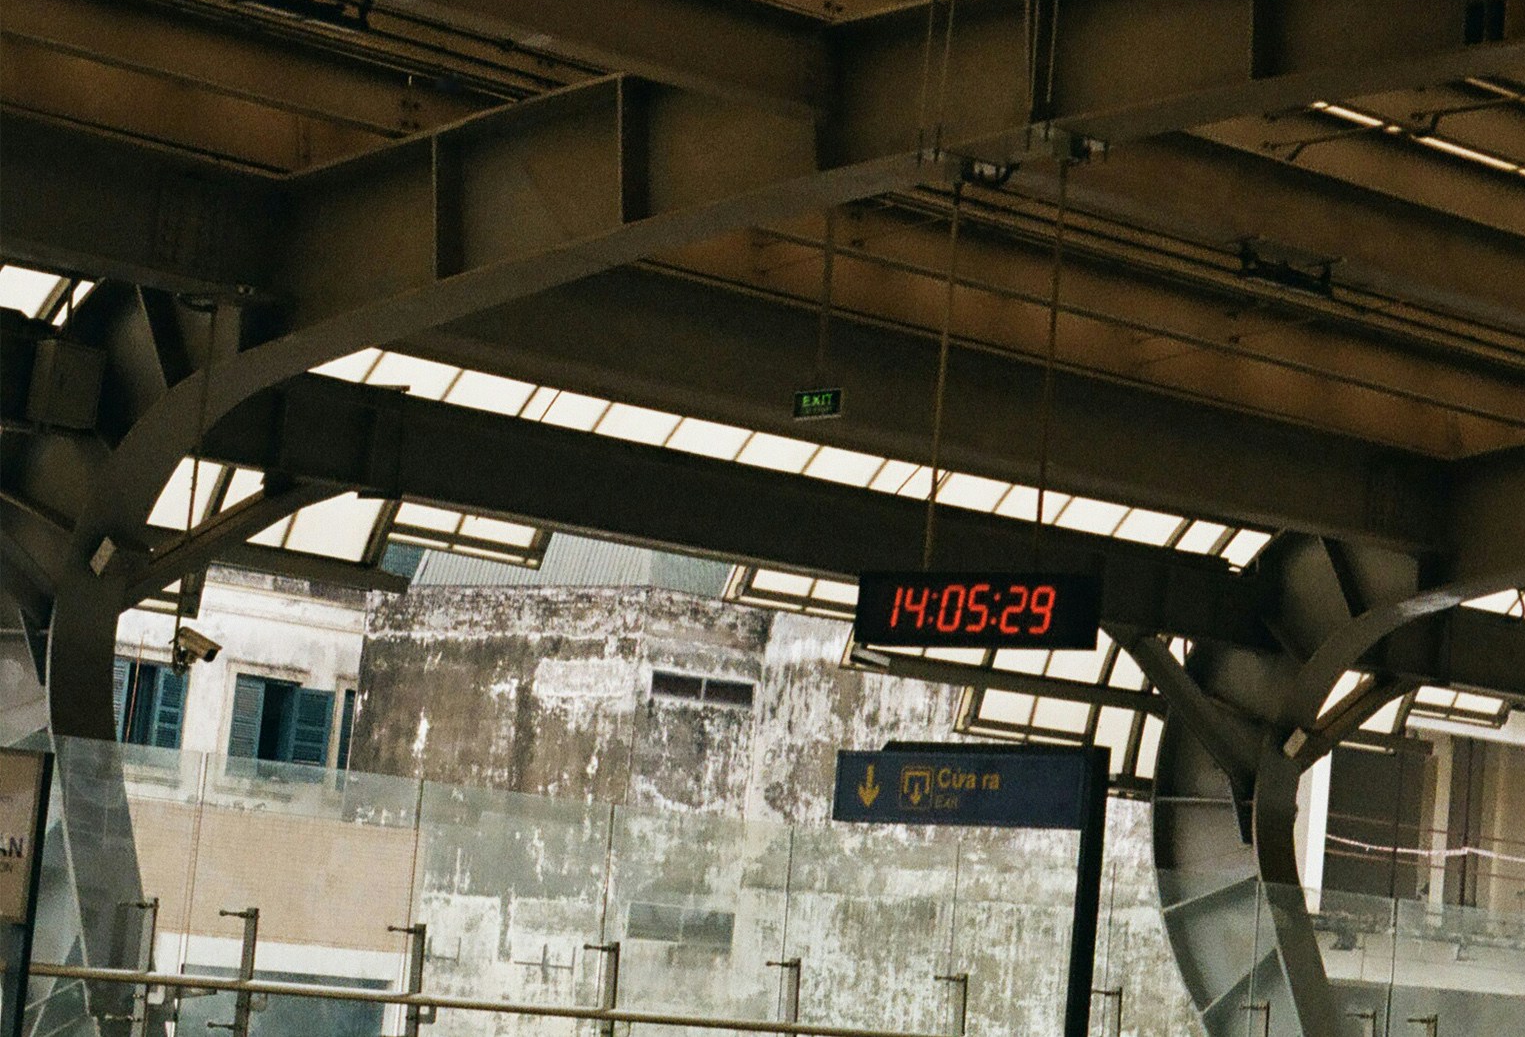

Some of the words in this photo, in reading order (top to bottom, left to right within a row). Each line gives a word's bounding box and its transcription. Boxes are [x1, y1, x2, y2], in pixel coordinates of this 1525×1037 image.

[802, 393, 833, 407] EXIT
[889, 583, 1057, 635] 14:05:29
[981, 772, 1001, 791] ra
